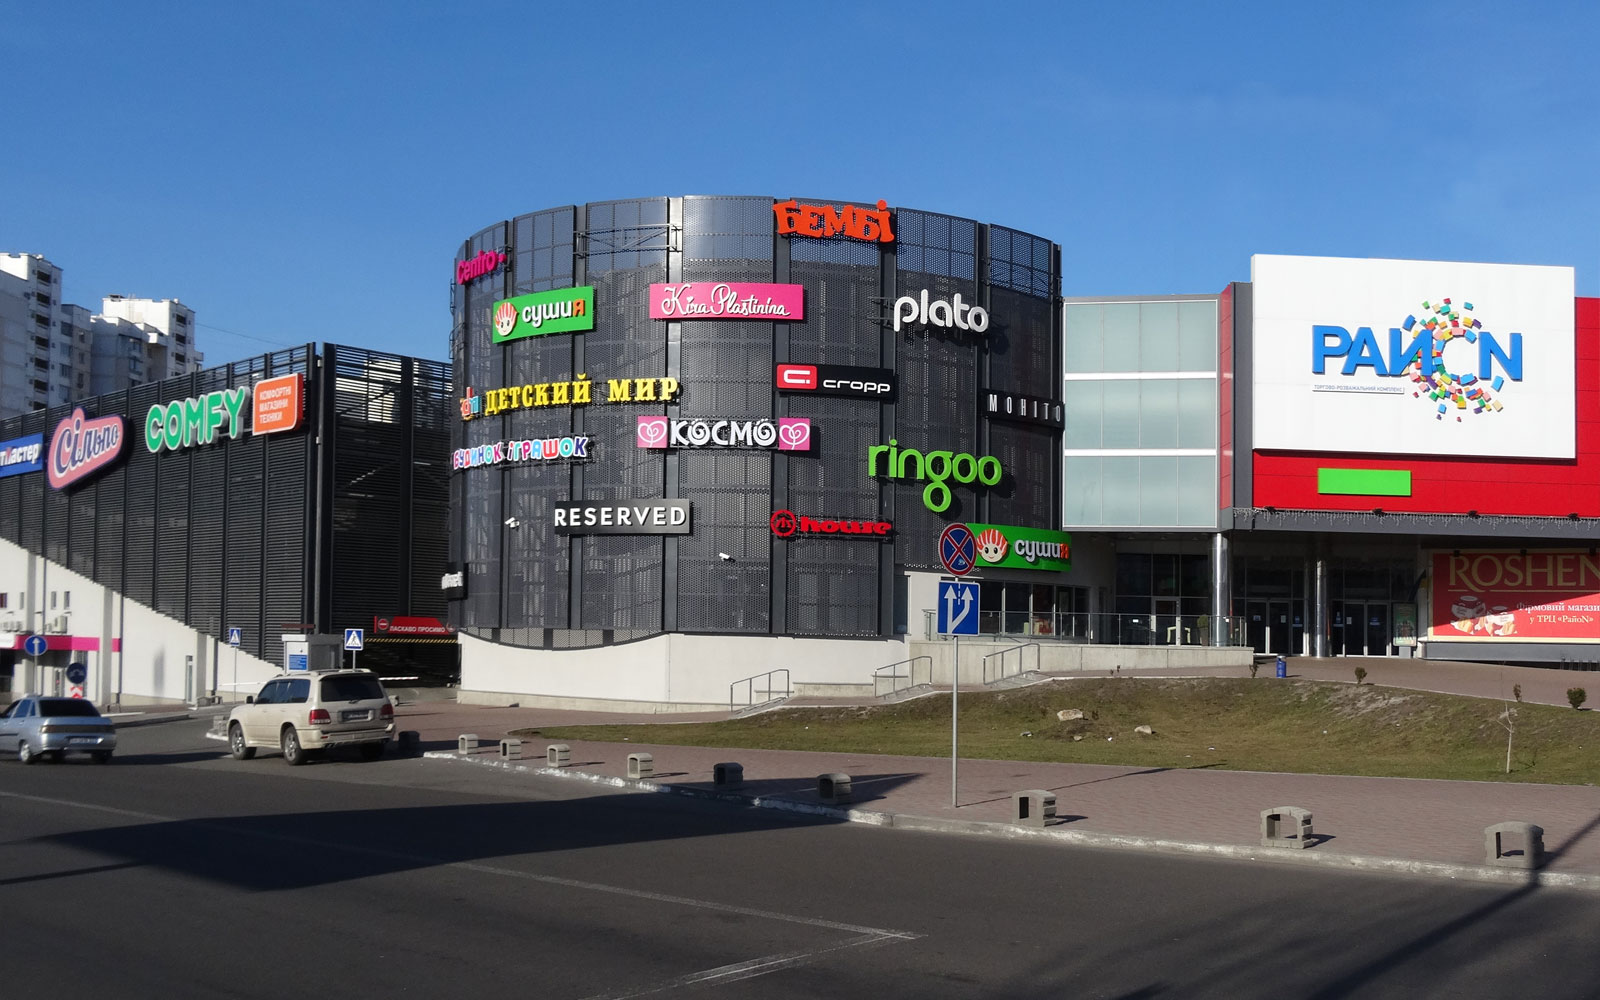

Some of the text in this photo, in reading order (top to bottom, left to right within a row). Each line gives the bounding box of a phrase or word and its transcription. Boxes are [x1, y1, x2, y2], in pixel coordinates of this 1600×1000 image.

[709, 283, 791, 316] Plastinina
[893, 289, 990, 333] plato
[485, 373, 593, 416] ДЕТСКИЙ
[607, 377, 680, 402] МИР
[823, 379, 891, 394] cropp
[145, 386, 251, 454] COMFY
[988, 393, 1061, 422] MOHITO
[54, 417, 120, 479] Сільпо
[453, 442, 502, 470] БУДИНОК
[868, 438, 1002, 513] ringoo
[554, 507, 686, 528] RESERVED
[1517, 602, 1565, 614] Фірмовий
[1537, 615, 1556, 624] ТРЦ
